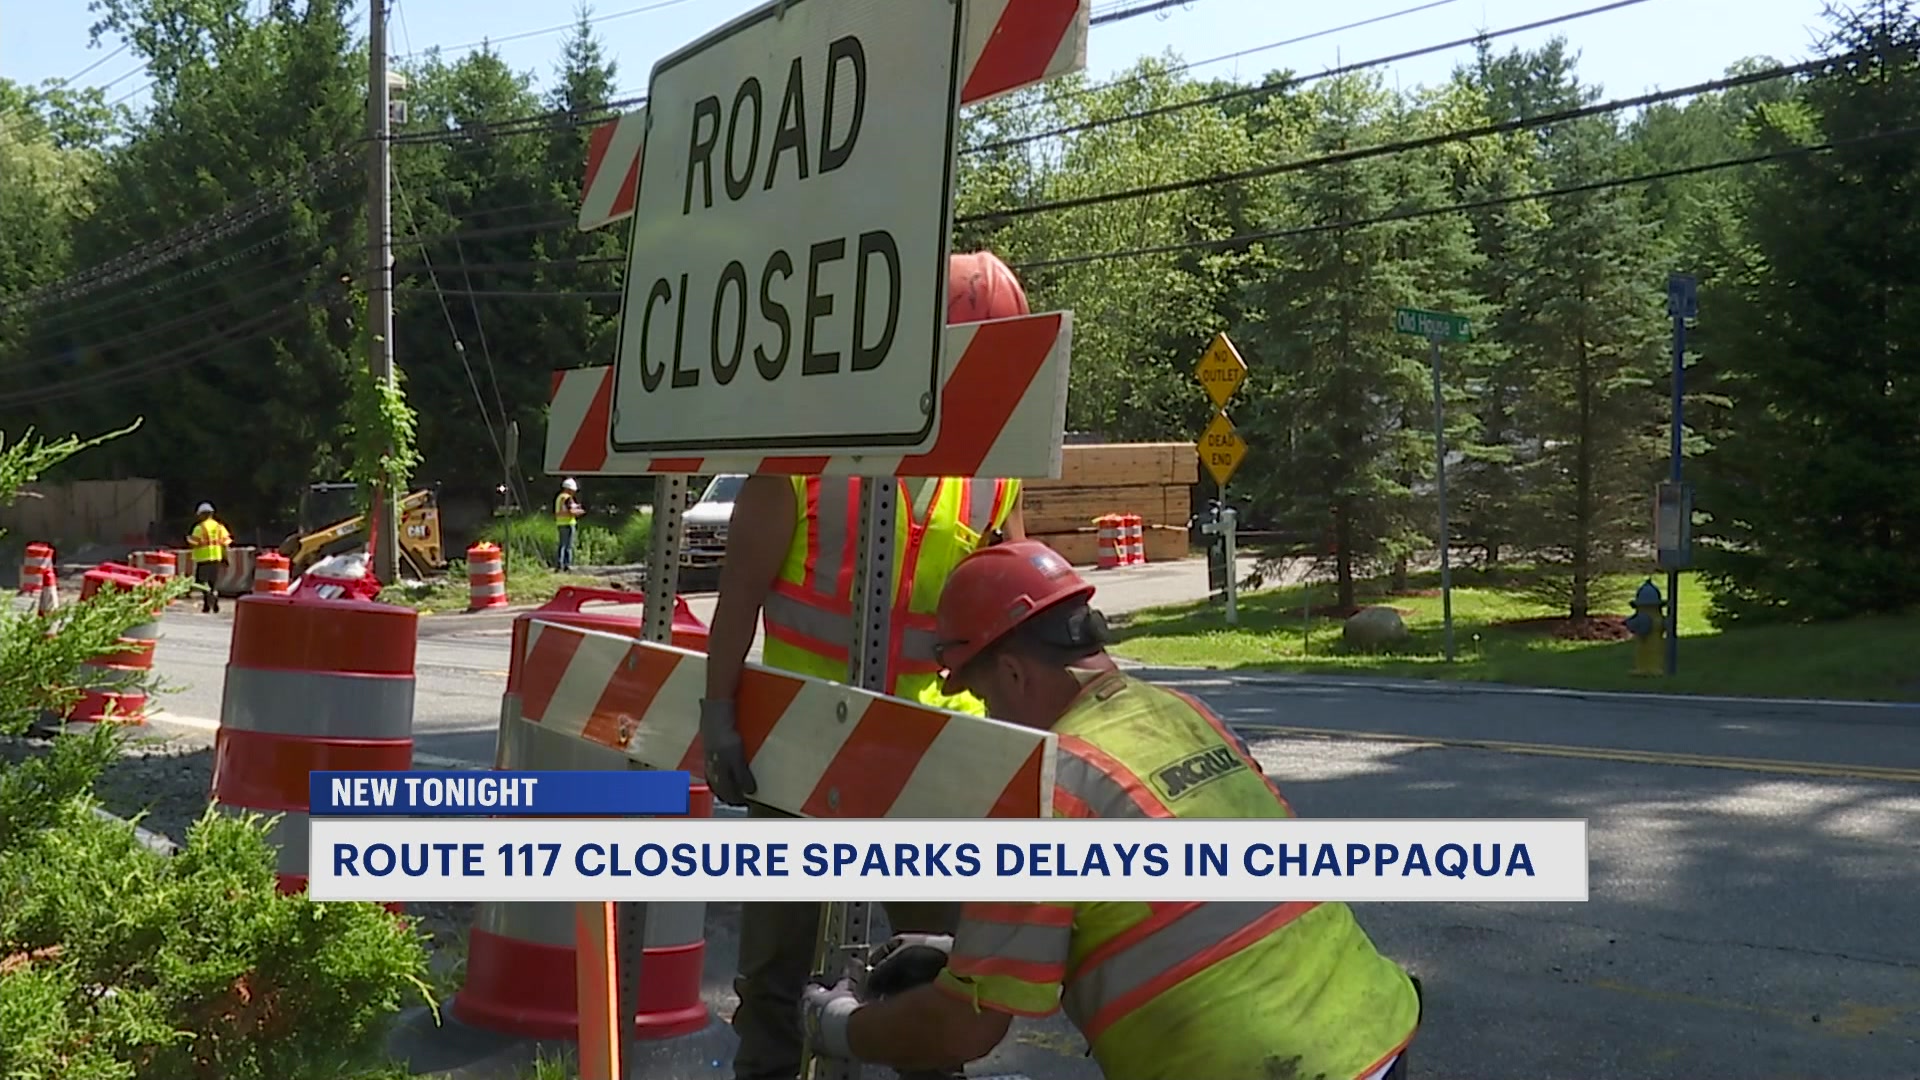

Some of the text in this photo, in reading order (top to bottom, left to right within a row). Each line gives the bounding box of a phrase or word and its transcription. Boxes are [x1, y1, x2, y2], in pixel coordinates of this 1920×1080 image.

[682, 35, 867, 216] ROAD
[640, 229, 901, 393] CLOSED
[1214, 350, 1228, 363] NO
[1203, 368, 1239, 383] OUTLET
[1208, 434, 1235, 447] DEAD
[1211, 453, 1232, 466] END
